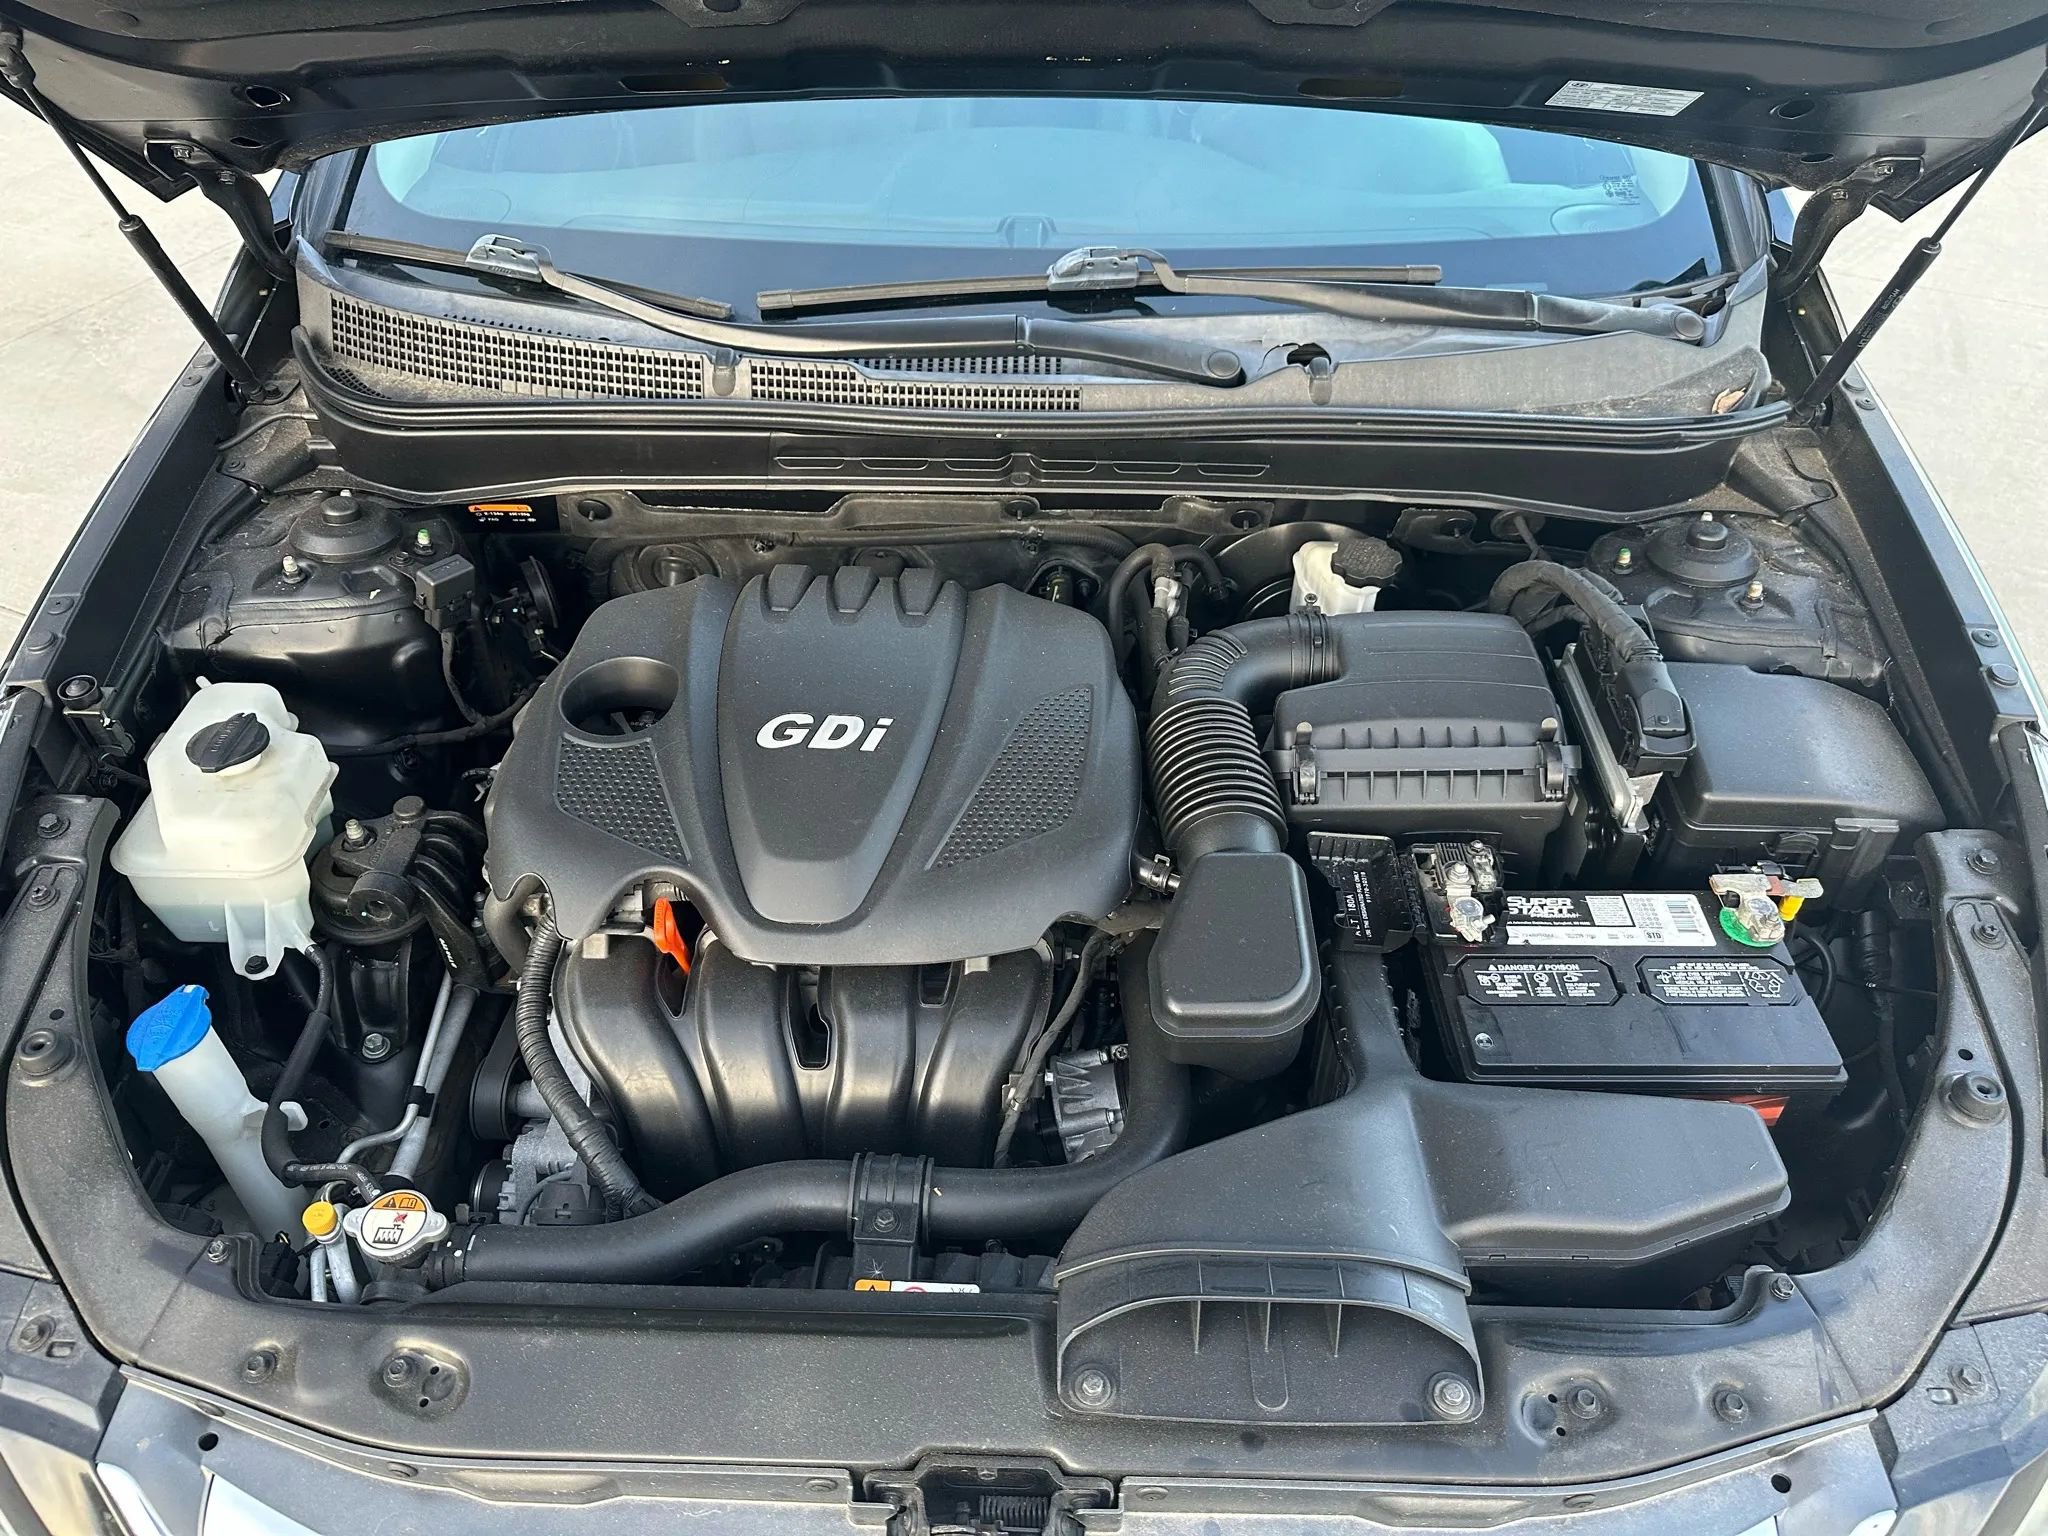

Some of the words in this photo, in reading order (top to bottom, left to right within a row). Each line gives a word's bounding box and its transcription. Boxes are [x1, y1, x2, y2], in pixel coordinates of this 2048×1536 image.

[756, 713, 893, 752] GDi
[1345, 894, 1357, 912] 180A
[1506, 896, 1573, 906] SUPER
[1646, 931, 1662, 939] STD
